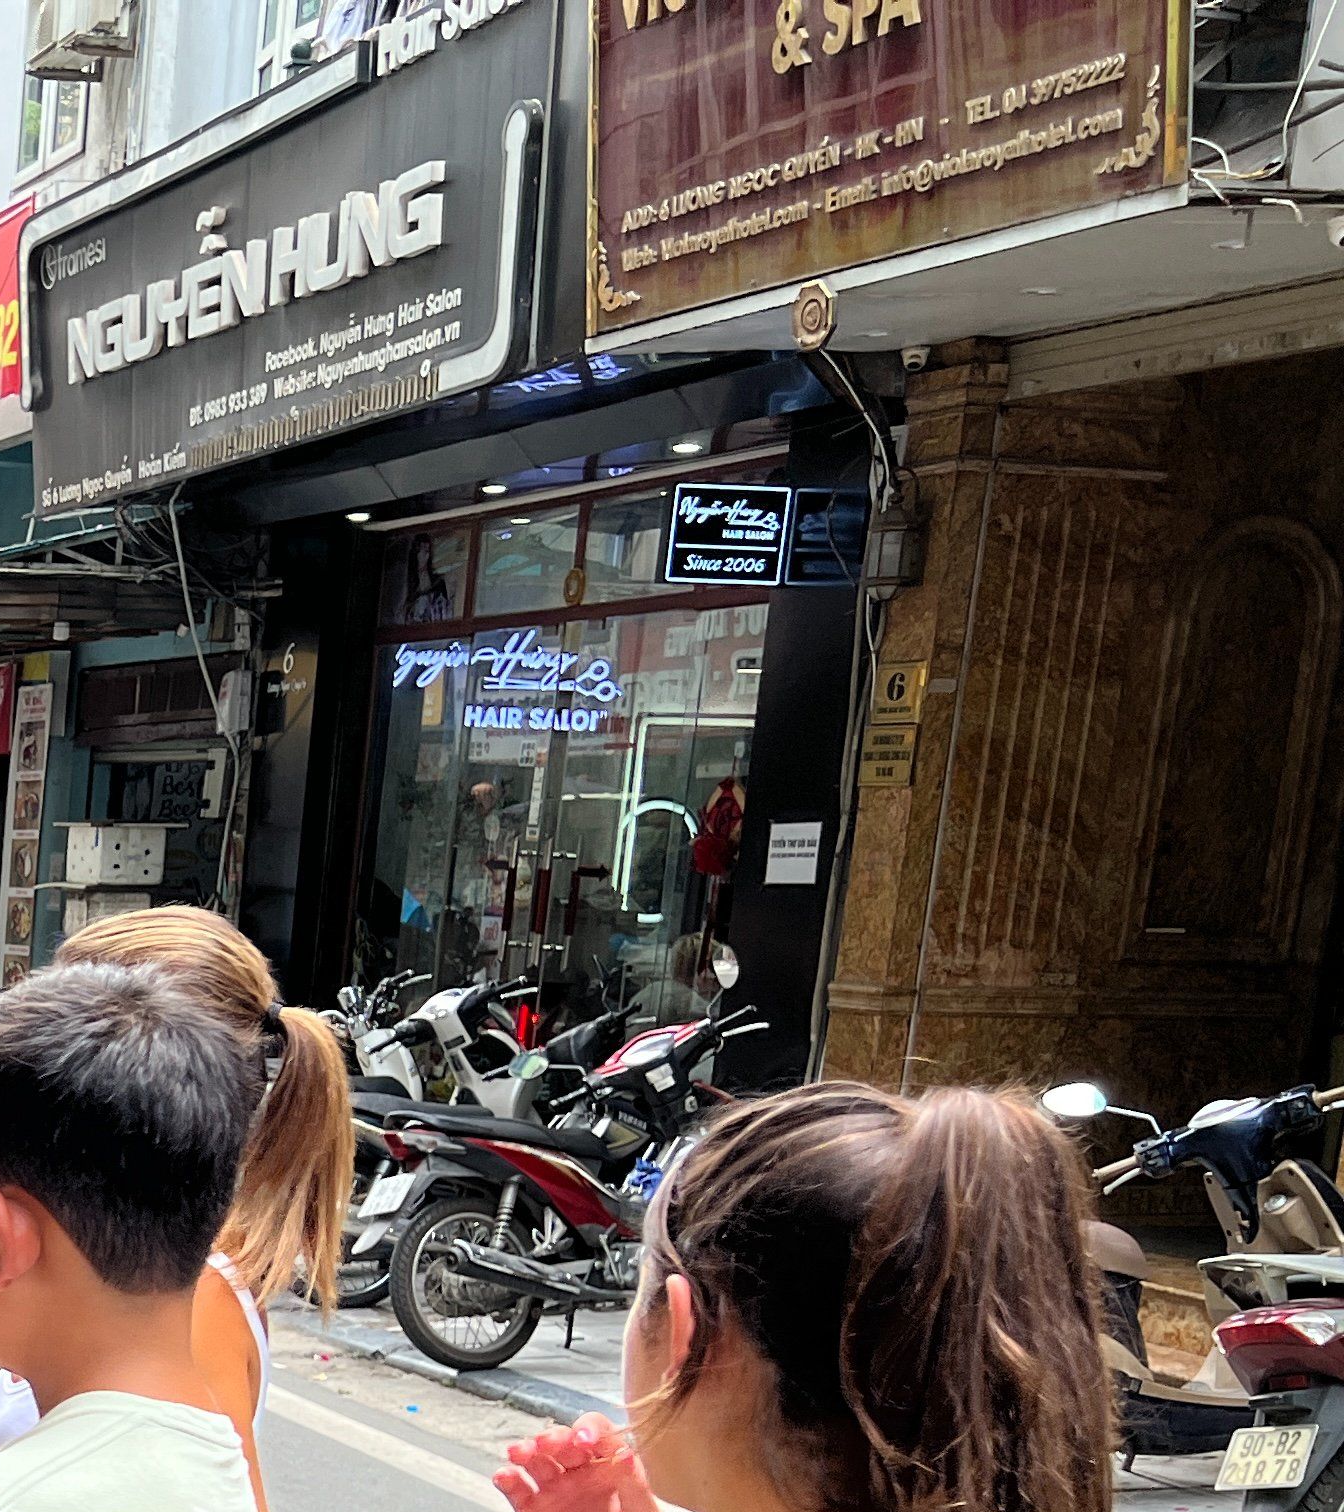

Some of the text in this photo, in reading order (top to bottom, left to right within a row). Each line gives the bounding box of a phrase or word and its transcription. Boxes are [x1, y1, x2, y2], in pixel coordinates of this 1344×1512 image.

[895, 117, 924, 147] HN
[398, 298, 425, 327] Hair
[426, 287, 462, 317] Salon
[722, 529, 775, 541] HAIR SALON
[684, 554, 766, 573] Since 2006
[283, 643, 296, 674] 6
[887, 672, 905, 701] 6
[464, 704, 524, 730] HAIR
